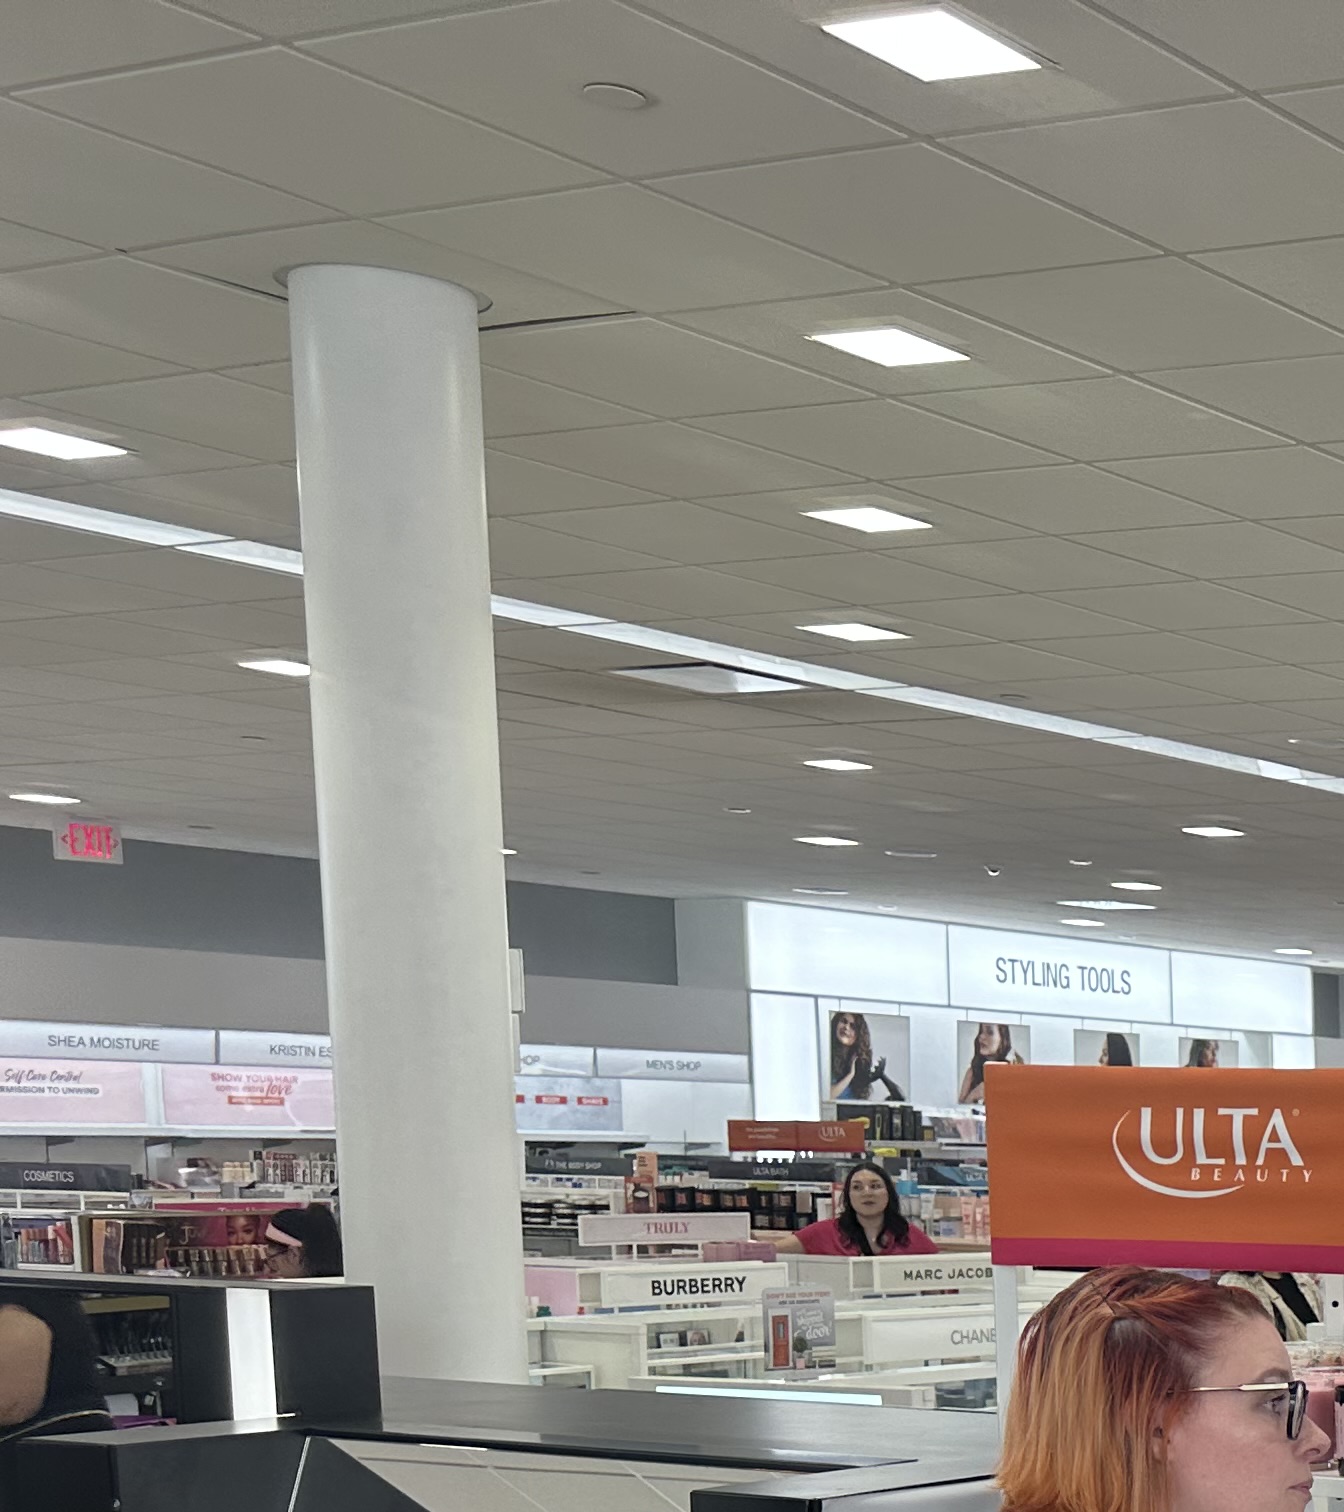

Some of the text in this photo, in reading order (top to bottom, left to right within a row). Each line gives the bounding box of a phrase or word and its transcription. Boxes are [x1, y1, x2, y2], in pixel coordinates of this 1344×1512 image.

[69, 823, 113, 859] EXIT
[995, 957, 1132, 996] STYLING TOOLS
[48, 1035, 160, 1051] SHEA MOISTURE
[269, 1044, 315, 1057] KRISTIN
[646, 1060, 702, 1072] MEN'S SHOP
[4, 1068, 24, 1084] Self
[211, 1072, 298, 1084] SHOW YOUR HAIR
[48, 1086, 100, 1095] TO UNWIND
[265, 1082, 293, 1097] love
[821, 1127, 846, 1139] ULTA
[1139, 1107, 1304, 1165] ULTA
[24, 1169, 75, 1183] COSMETICS
[1190, 1167, 1313, 1183] BEAUTY
[643, 1222, 691, 1235] TRULY
[903, 1267, 994, 1281] MARC JACOB
[651, 1276, 747, 1297] BURBERRY
[951, 1328, 996, 1345] CHANE
